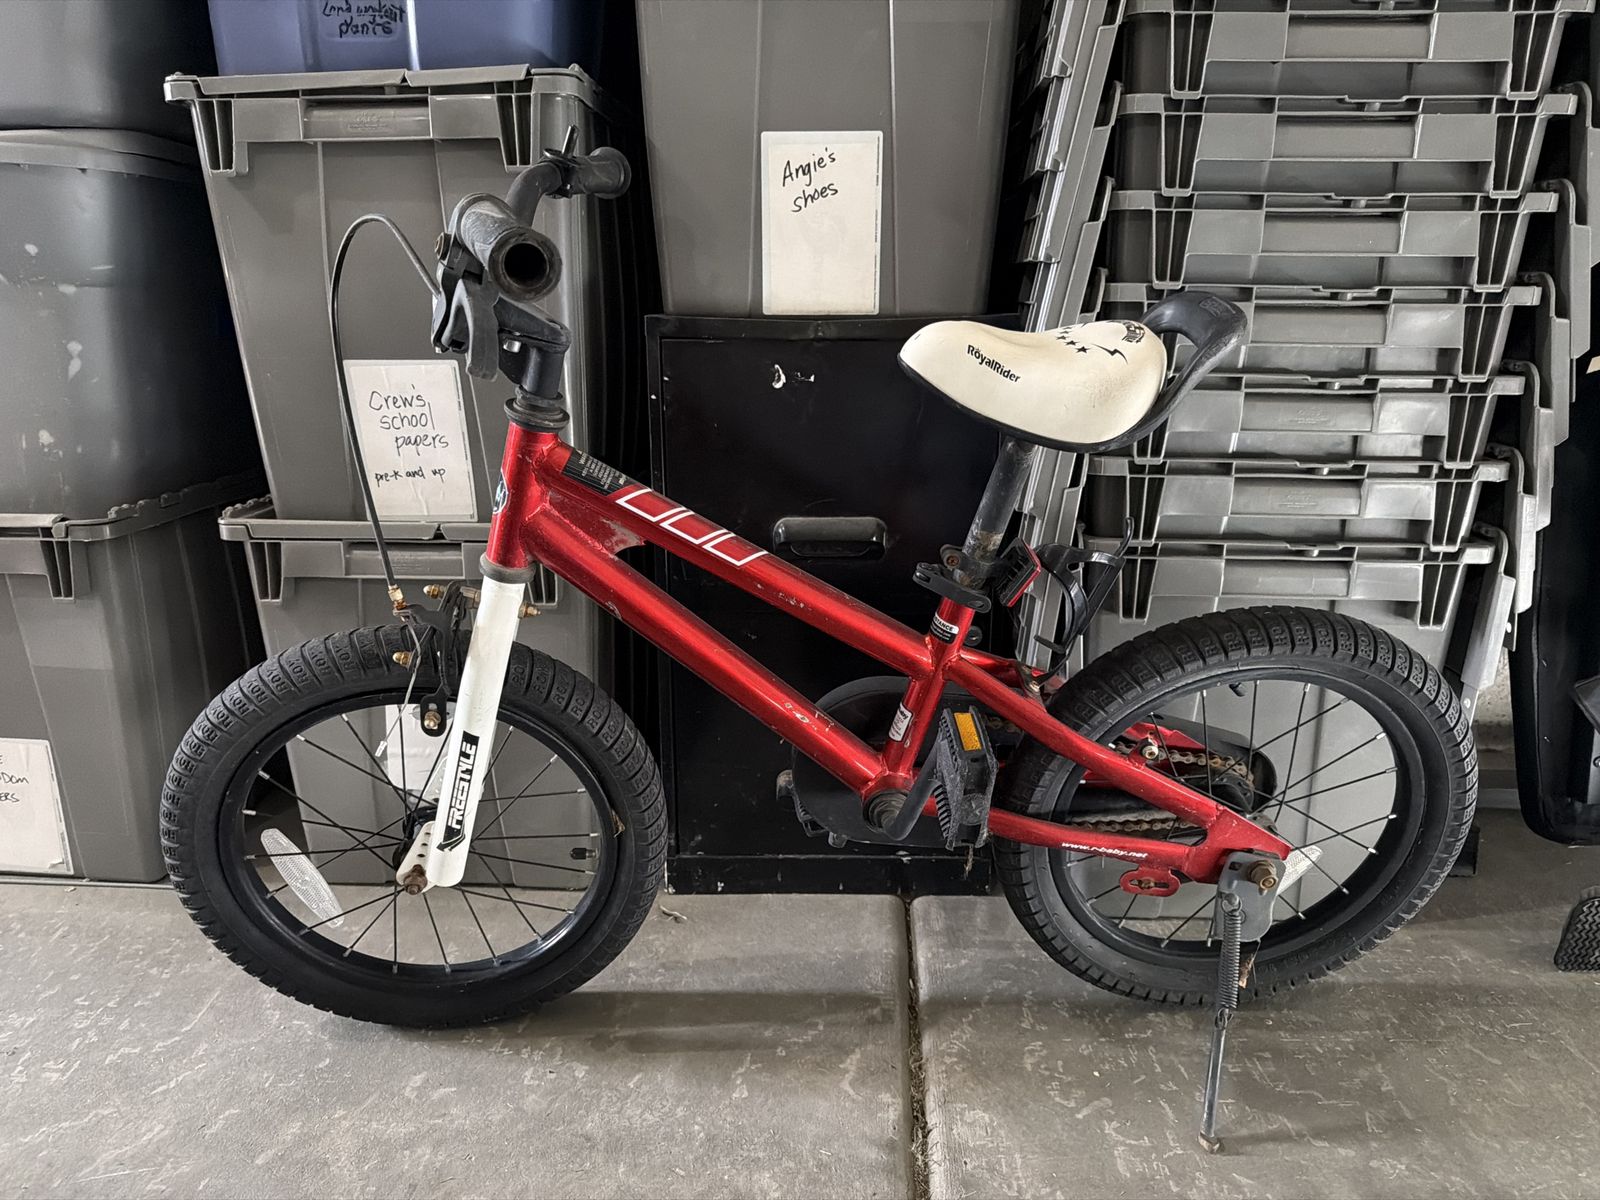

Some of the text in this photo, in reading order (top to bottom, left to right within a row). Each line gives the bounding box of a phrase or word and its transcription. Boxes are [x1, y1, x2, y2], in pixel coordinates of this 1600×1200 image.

[782, 146, 836, 187] Angie's
[791, 183, 838, 213] shoes
[369, 384, 426, 411] Crew's
[380, 402, 435, 430] school
[395, 434, 449, 456] papers
[406, 466, 426, 479] and
[432, 468, 446, 483] up
[448, 741, 477, 829] FREESTYLE
